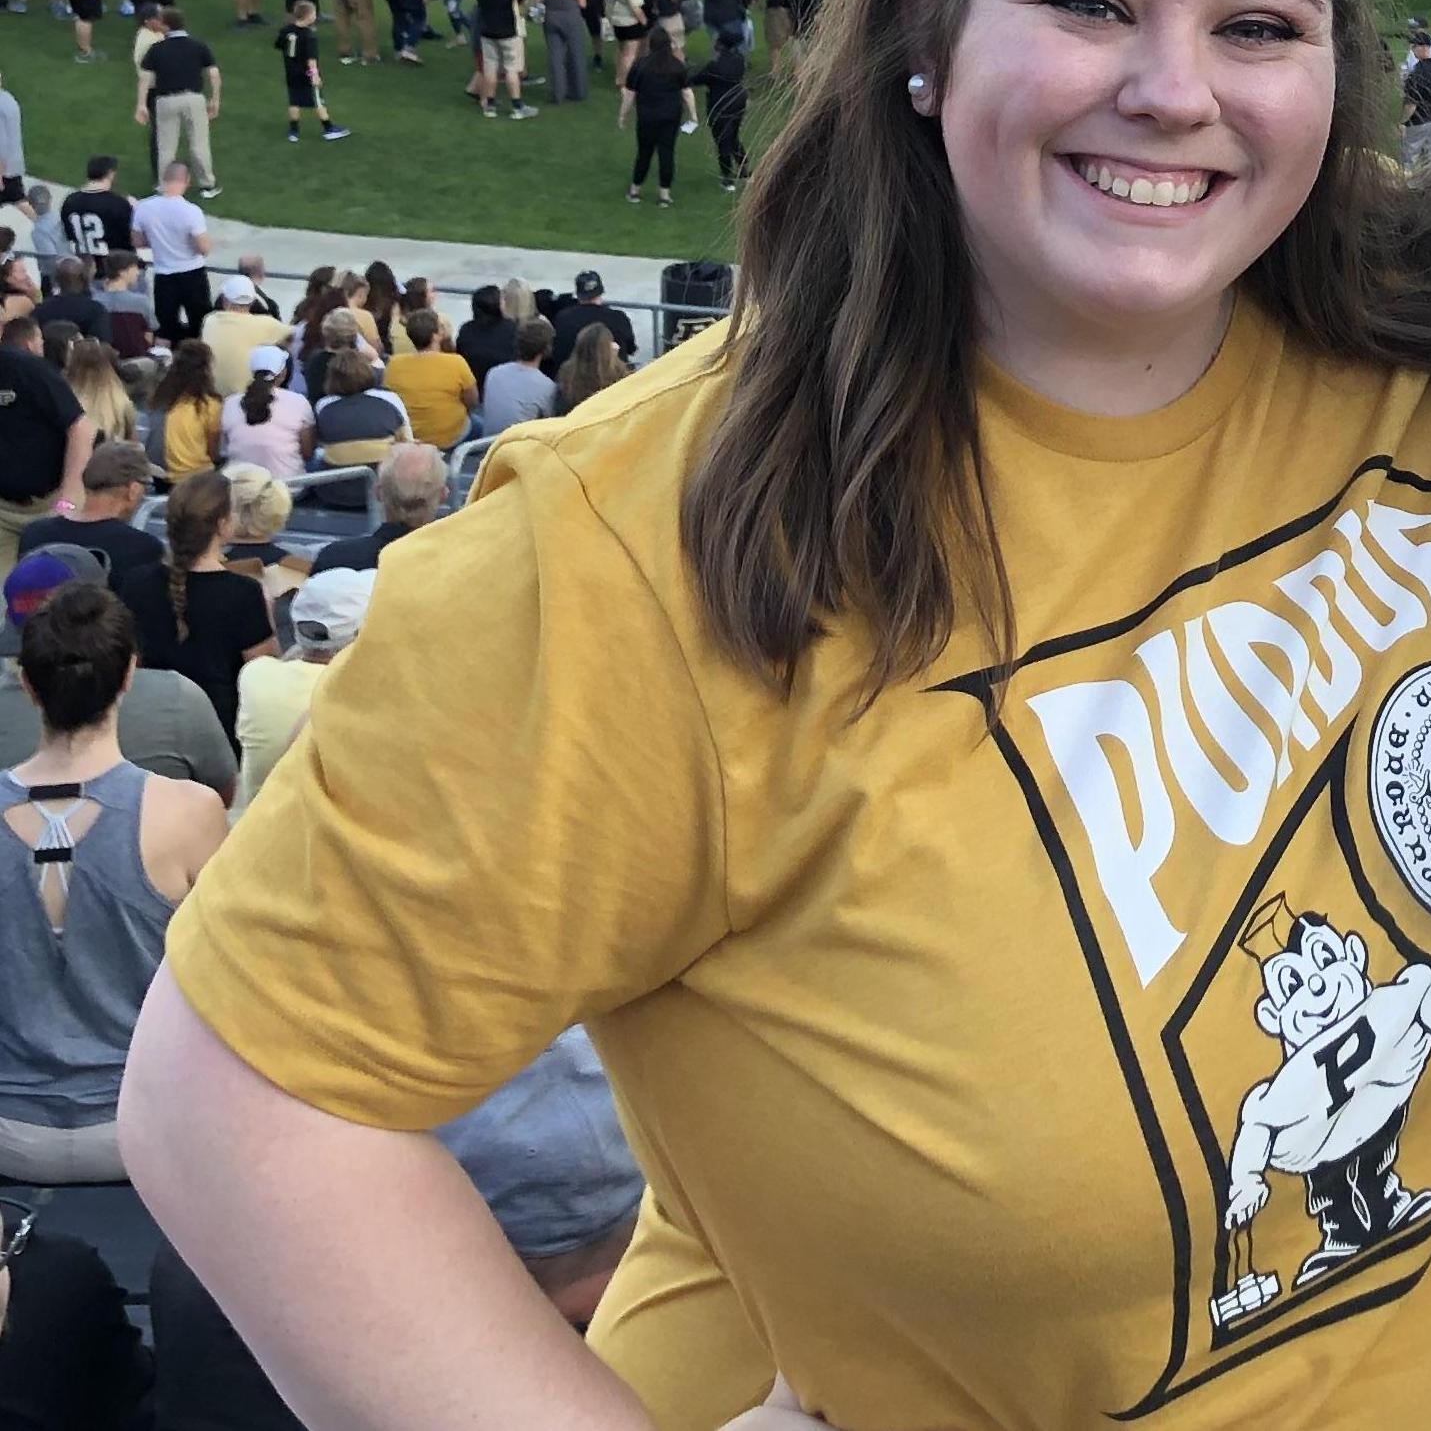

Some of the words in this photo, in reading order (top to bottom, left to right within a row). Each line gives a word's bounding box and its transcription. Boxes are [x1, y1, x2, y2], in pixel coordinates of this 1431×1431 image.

[287, 32, 297, 58] 1
[69, 212, 109, 256] 12
[1314, 1015, 1376, 1119] P
